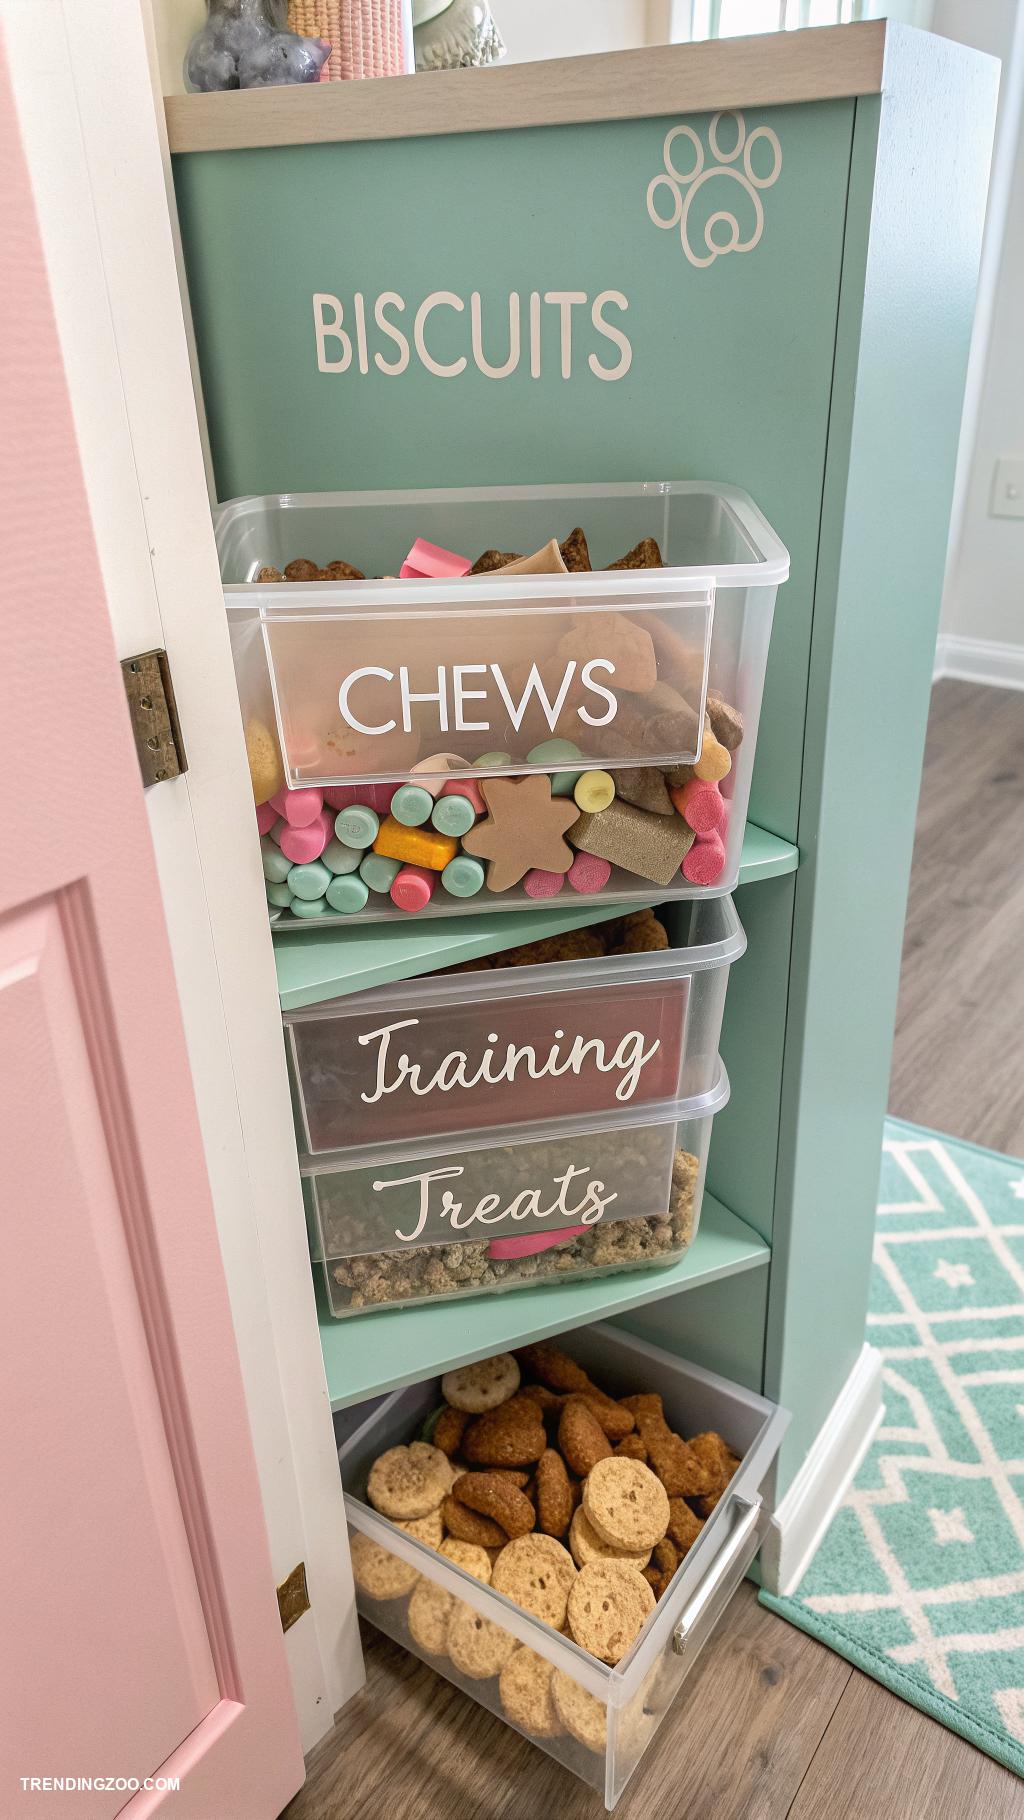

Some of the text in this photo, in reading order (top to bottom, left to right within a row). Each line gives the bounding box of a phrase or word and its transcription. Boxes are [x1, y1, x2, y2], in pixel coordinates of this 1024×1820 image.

[313, 289, 633, 381] BISCUITS
[338, 657, 619, 736] CHEWS
[358, 1018, 661, 1103] Training
[372, 1163, 618, 1242] Treats
